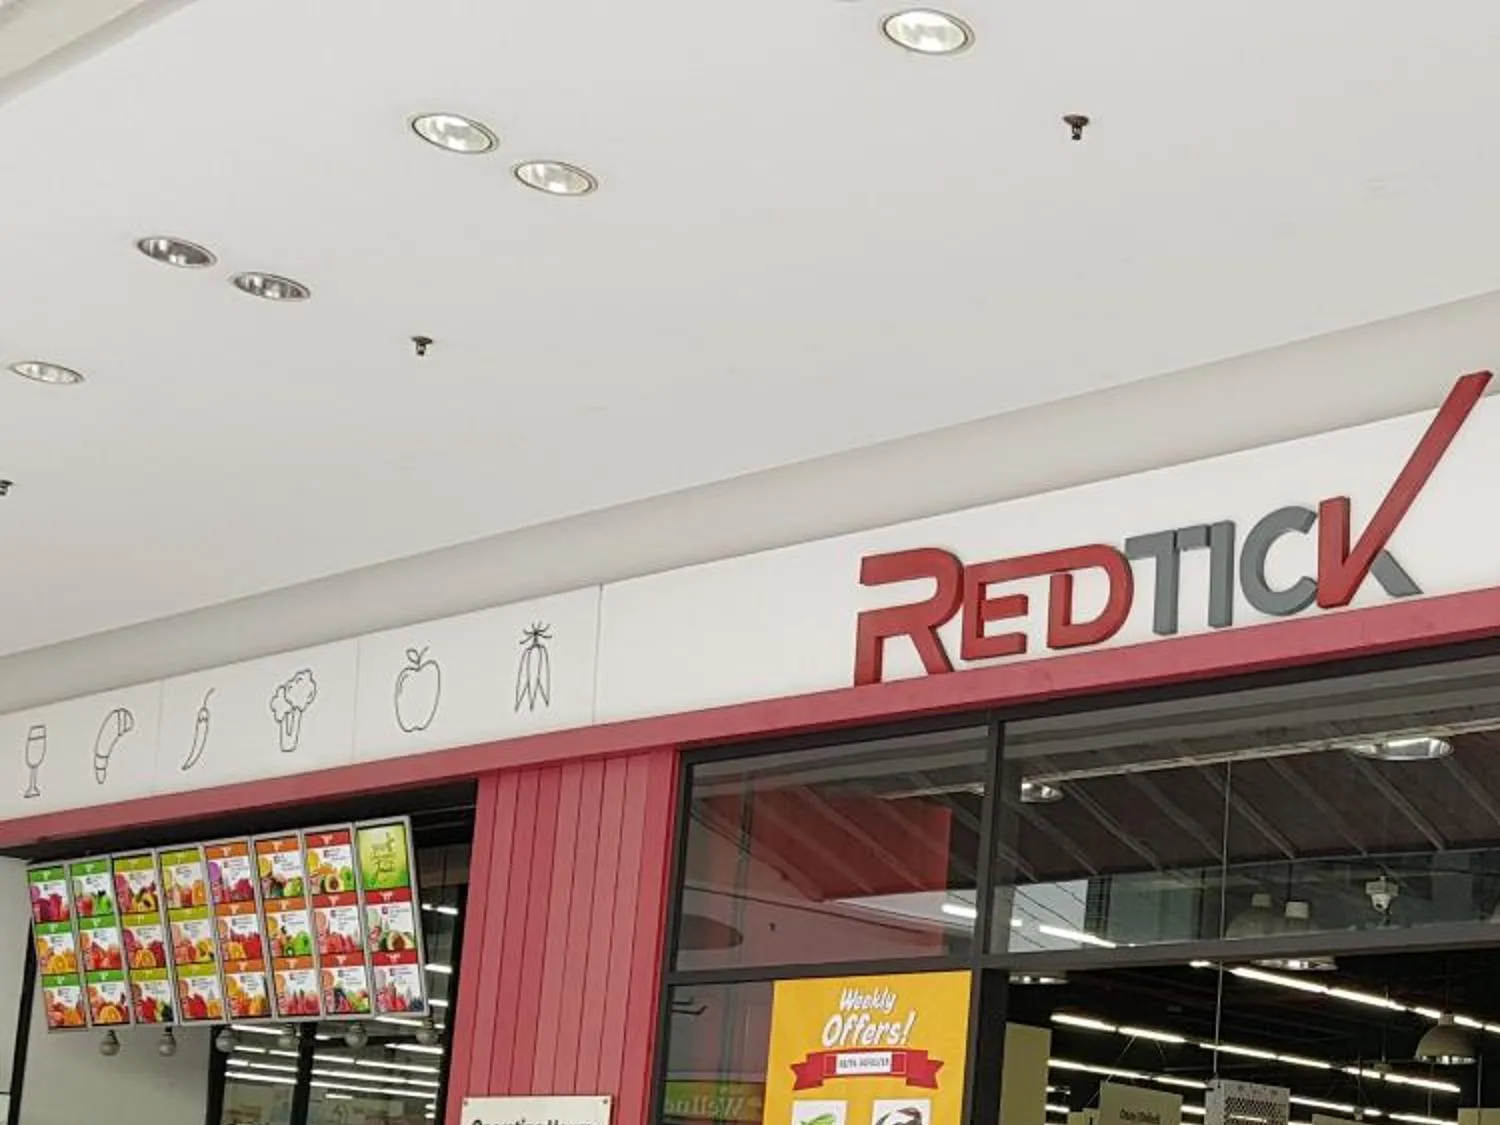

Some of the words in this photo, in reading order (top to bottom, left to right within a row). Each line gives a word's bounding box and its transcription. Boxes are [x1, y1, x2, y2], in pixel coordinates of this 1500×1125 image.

[855, 371, 1493, 686] REDTICK
[839, 985, 897, 1014] Weekly
[822, 1008, 917, 1047] Offers!
